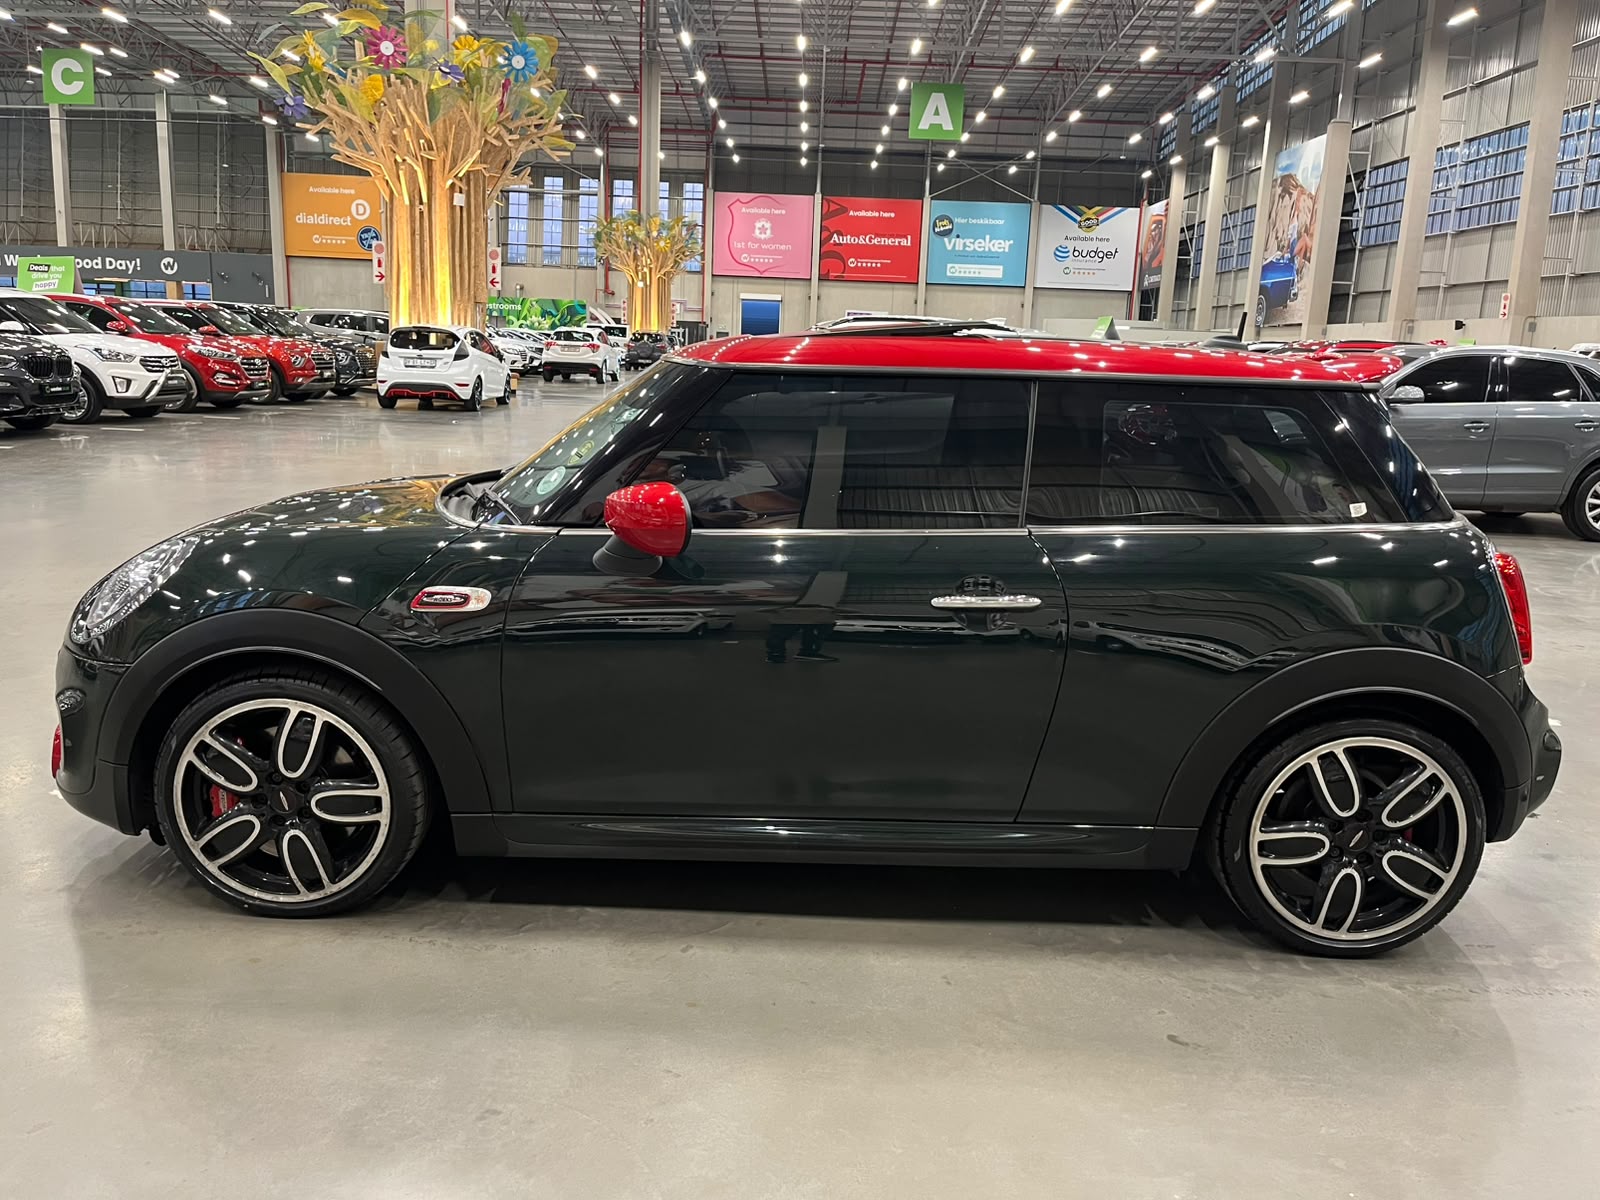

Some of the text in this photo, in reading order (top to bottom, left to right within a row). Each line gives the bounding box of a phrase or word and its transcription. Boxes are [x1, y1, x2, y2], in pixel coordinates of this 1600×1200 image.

[51, 57, 84, 95] C
[918, 92, 954, 130] A
[309, 186, 339, 194] Available
[295, 213, 352, 226] dialdirect
[968, 217, 1005, 225] beskikbaar
[733, 241, 792, 251] 1st for women
[830, 233, 911, 246] Auto&General
[943, 234, 1014, 252] virseker
[1072, 246, 1119, 263] budget
[75, 257, 141, 274] ood Day!
[35, 281, 57, 289] happy
